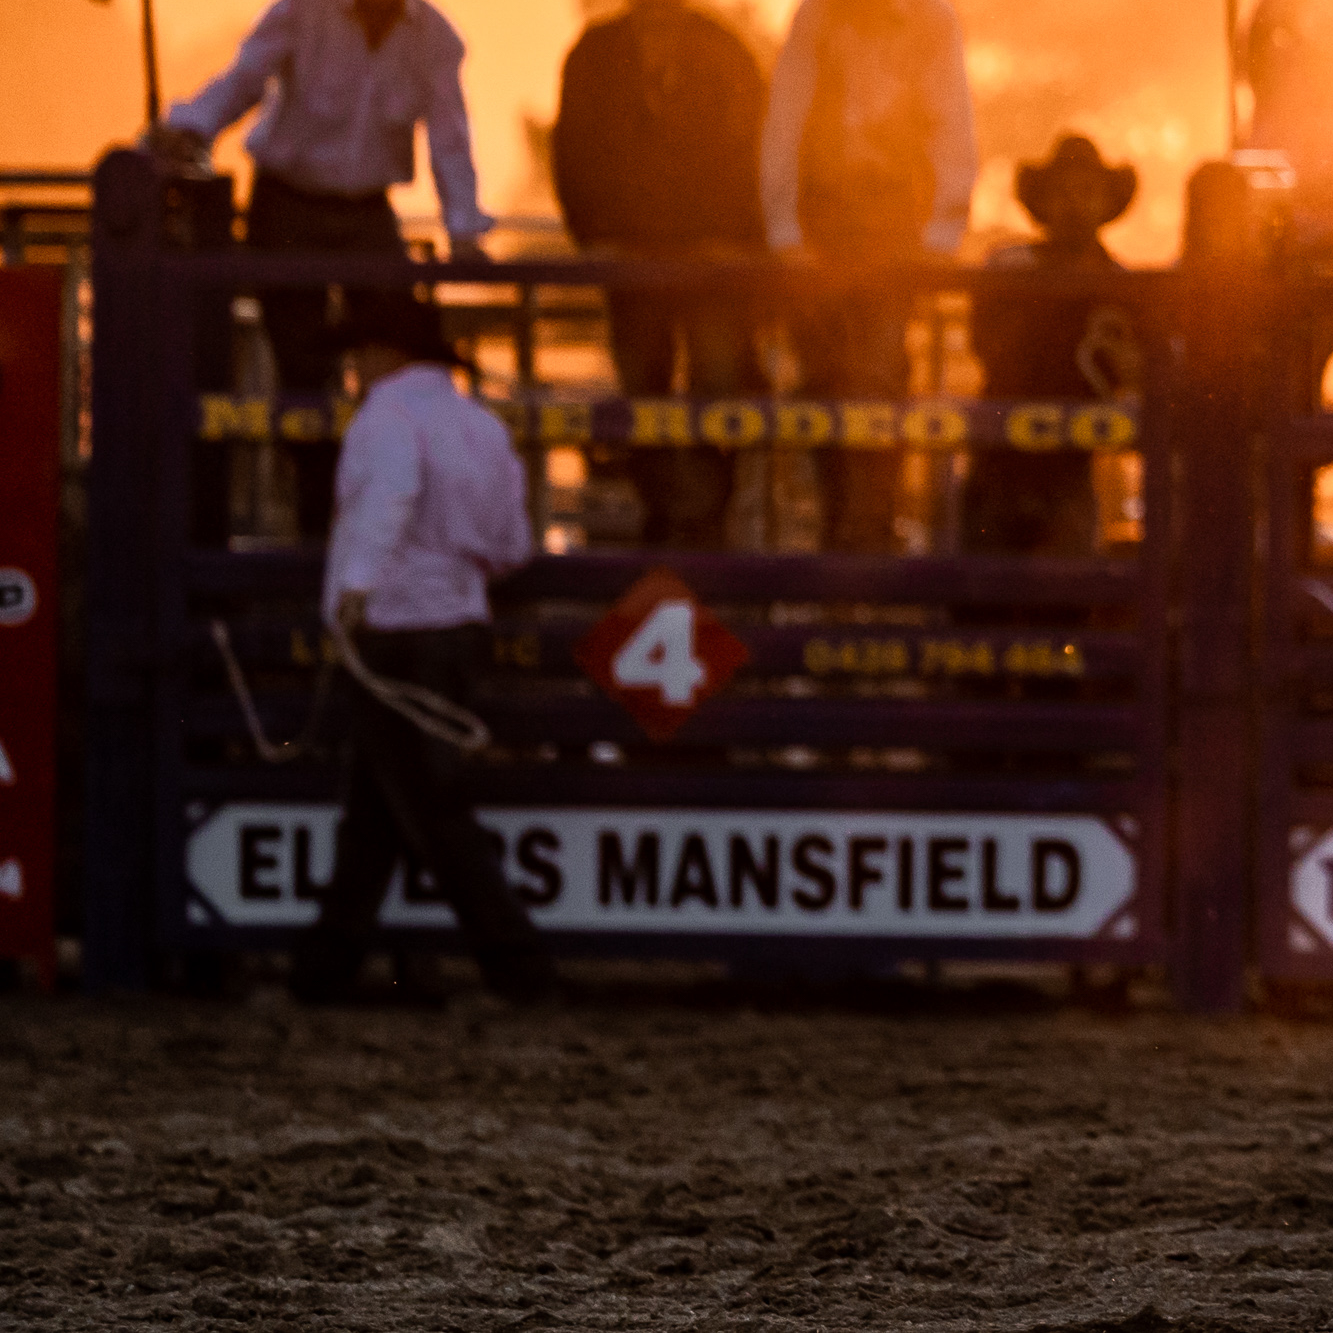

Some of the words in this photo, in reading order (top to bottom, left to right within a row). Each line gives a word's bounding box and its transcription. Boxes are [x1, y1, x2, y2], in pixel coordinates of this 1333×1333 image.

[632, 404, 968, 449] RODEO
[1006, 406, 1136, 452] CO
[610, 597, 708, 708] 4
[598, 831, 1082, 912] MANSFIELD
